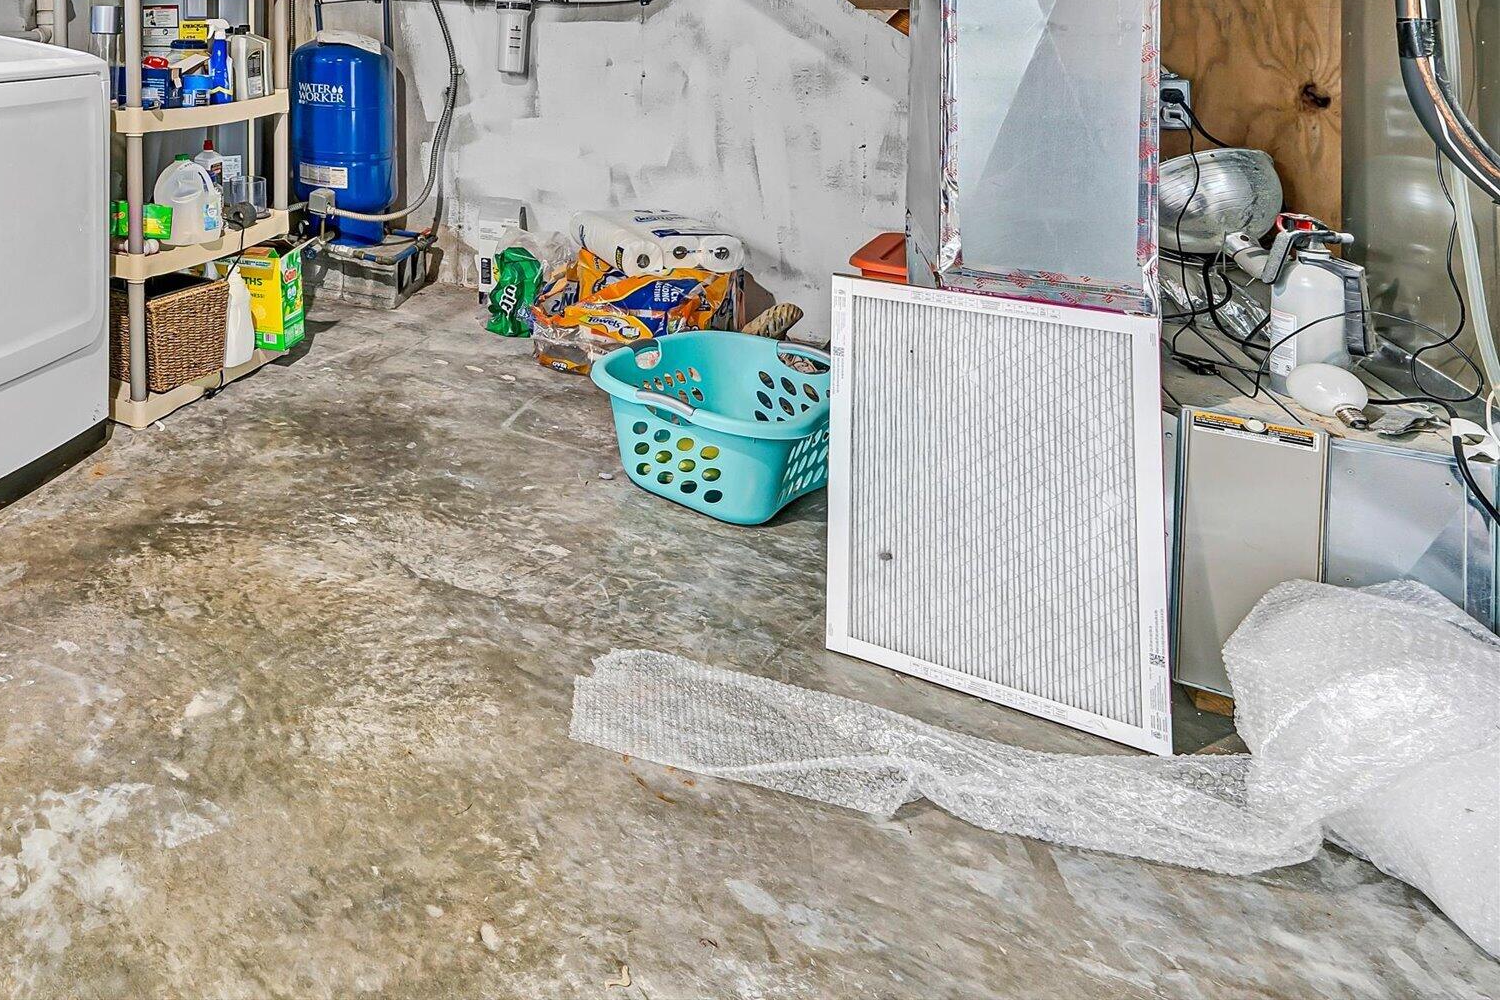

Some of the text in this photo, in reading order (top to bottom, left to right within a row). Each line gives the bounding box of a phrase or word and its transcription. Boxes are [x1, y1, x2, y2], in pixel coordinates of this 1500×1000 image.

[298, 82, 331, 94] WATER
[298, 91, 346, 103] WORKER
[587, 315, 623, 329] Towels
